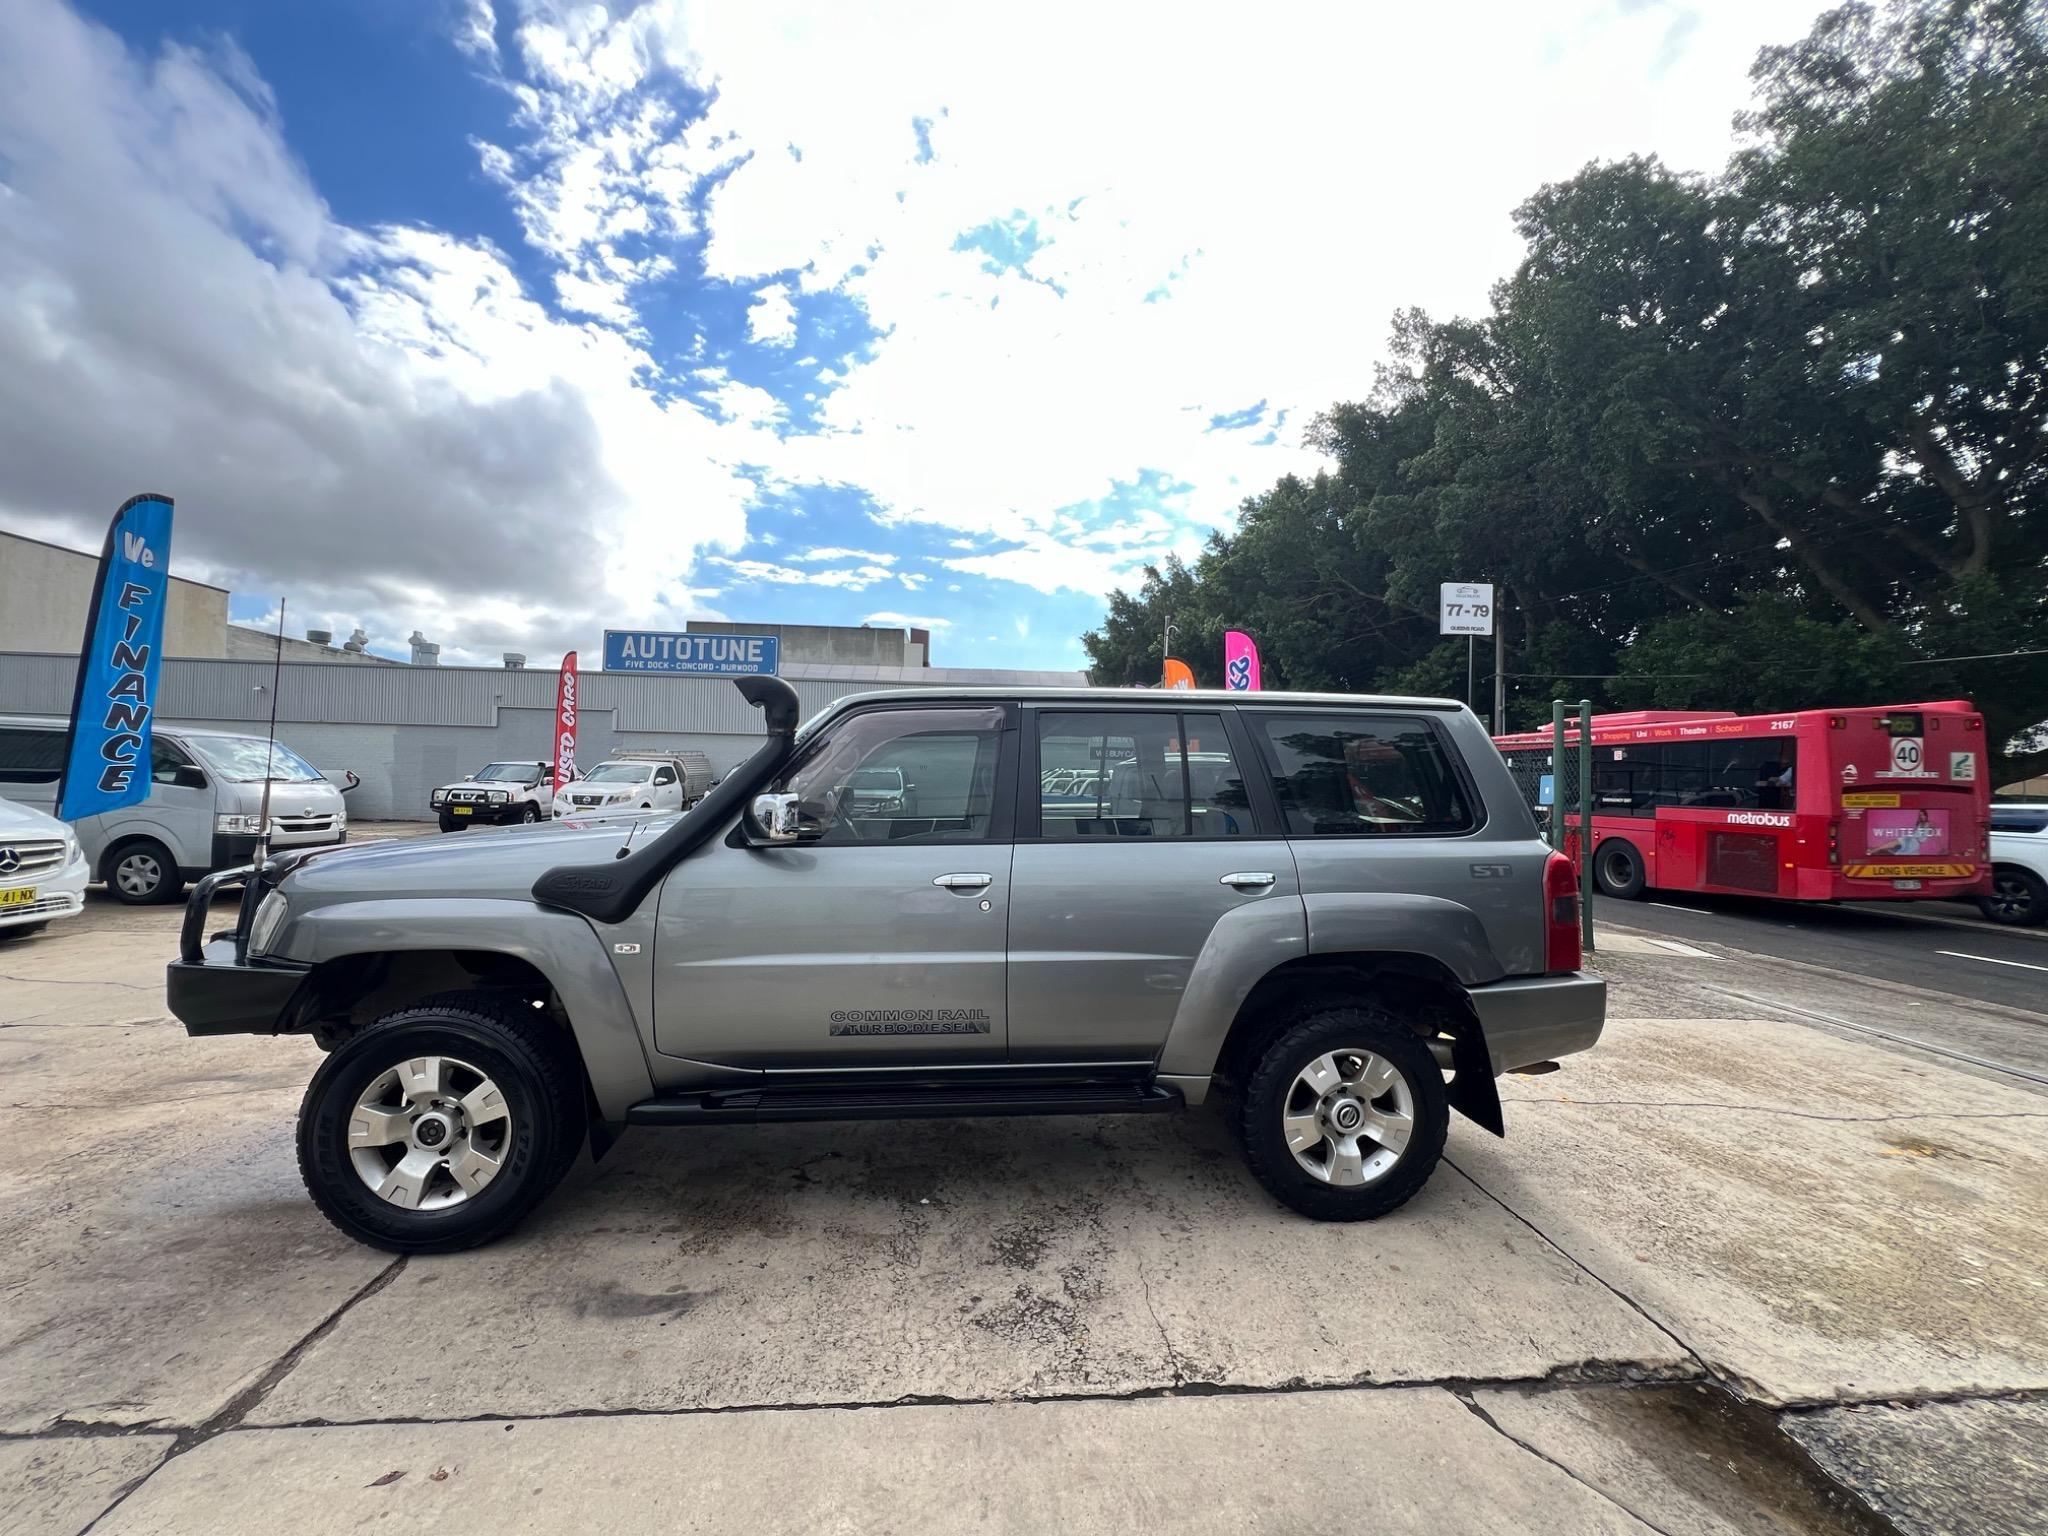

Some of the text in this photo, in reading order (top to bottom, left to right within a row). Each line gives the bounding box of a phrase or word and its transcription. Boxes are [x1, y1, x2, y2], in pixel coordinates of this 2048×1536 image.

[621, 635, 764, 662] AUTOTUNE
[625, 661, 645, 669] FIVE
[676, 662, 714, 670] CONCORD
[721, 663, 759, 672] BURWOOD
[97, 582, 151, 793] FINANCE
[1636, 730, 1648, 738] Uni
[1679, 727, 1707, 735] Theatre
[1715, 724, 1744, 733] School
[1770, 720, 1795, 730] 2167
[558, 731, 575, 783] USED
[1896, 747, 1919, 763] 40
[1727, 812, 1790, 827] metrobus
[1873, 828, 1943, 837] WHITE FOX
[1473, 865, 1510, 877] ST
[1872, 865, 1945, 876] LONG VEHICLE
[565, 875, 612, 890] SAFARI
[831, 1009, 990, 1022] COMMON RAIL
